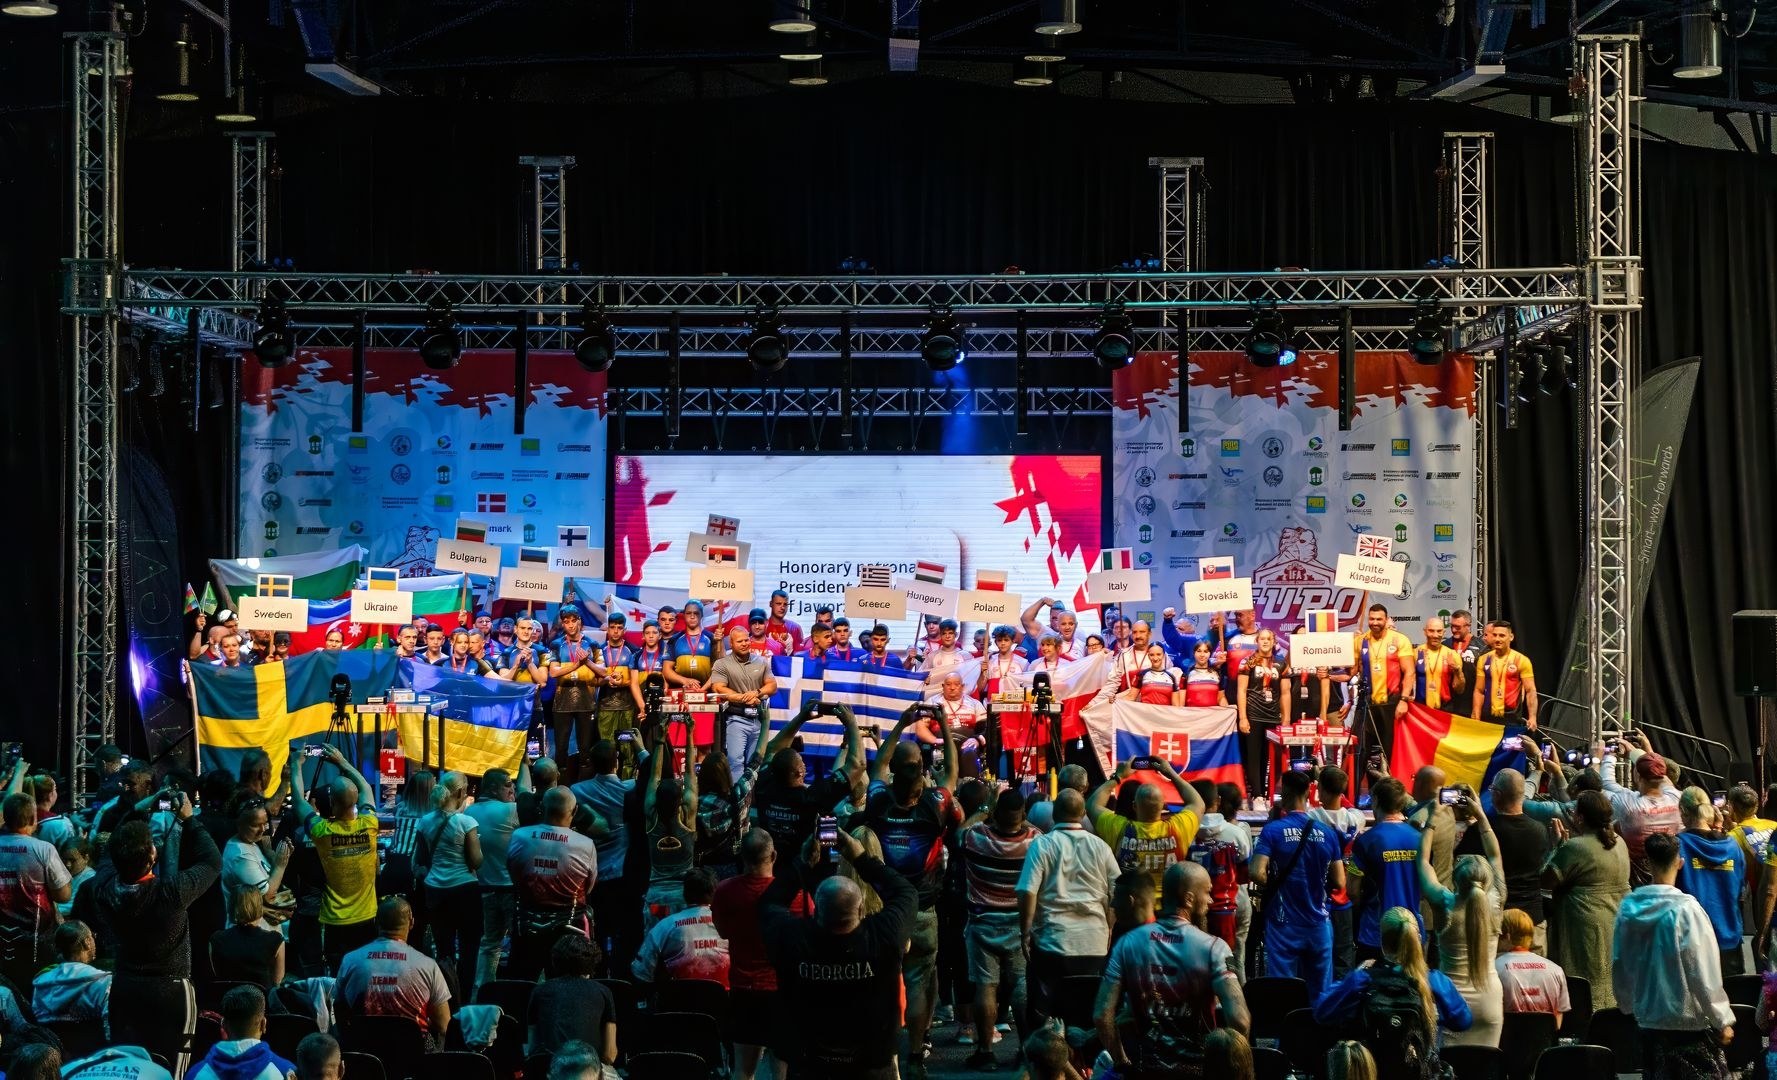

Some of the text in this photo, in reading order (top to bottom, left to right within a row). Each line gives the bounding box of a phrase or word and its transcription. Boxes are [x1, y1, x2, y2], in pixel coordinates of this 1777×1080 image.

[489, 525, 512, 533] mark
[450, 551, 487, 564] Bulgaria
[556, 558, 590, 567] Finland
[780, 561, 851, 577] Honorary
[1358, 562, 1385, 575] Unite
[1349, 571, 1391, 585] Kingdom
[515, 580, 548, 590] Estonia
[707, 579, 736, 589] Serbia
[1108, 581, 1128, 592] Italy
[906, 590, 945, 606] Hungary
[1198, 591, 1239, 601] Slovakia
[364, 602, 398, 612] Ukraine
[858, 598, 891, 609] Greece
[973, 602, 1005, 613] Poland
[254, 609, 293, 620] Sweden
[1303, 645, 1342, 655] Romania
[387, 758, 397, 773] 1
[1121, 836, 1177, 851] ROMANIA
[1145, 853, 1178, 870] IFA
[694, 939, 718, 949] TEAM
[799, 961, 875, 981] GEORGIA
[372, 976, 398, 985] TEAM
